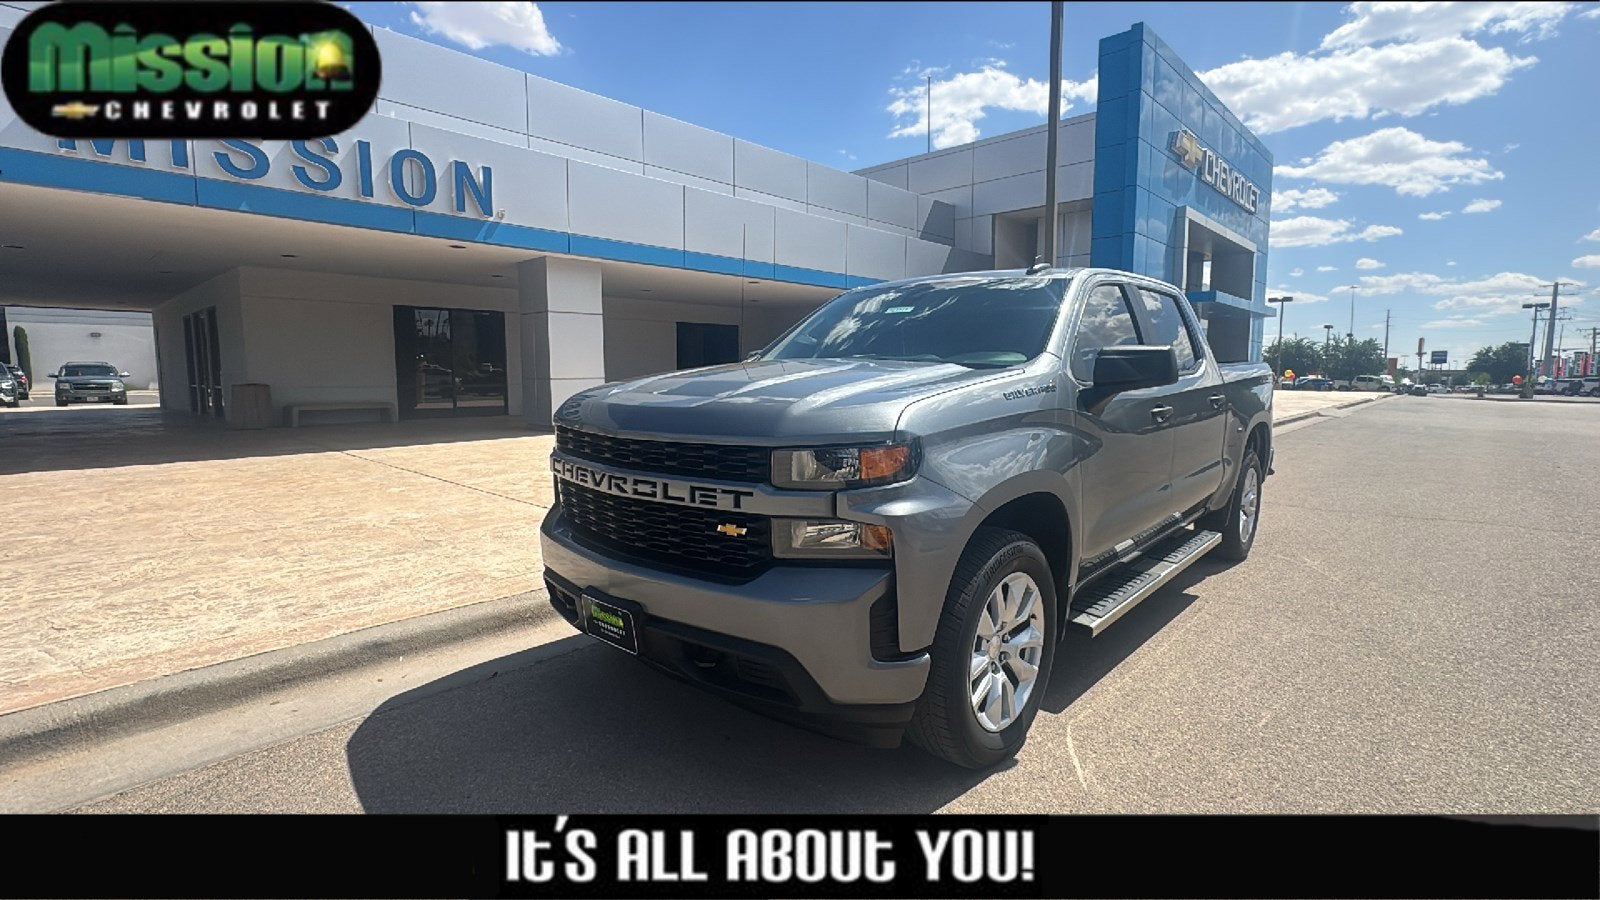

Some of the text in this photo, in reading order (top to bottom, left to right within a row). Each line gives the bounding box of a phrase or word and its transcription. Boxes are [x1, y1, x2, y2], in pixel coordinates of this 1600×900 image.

[56, 139, 493, 218] SSION
[1202, 148, 1260, 214] CHEVROLET
[552, 458, 754, 509] CHEVROLET
